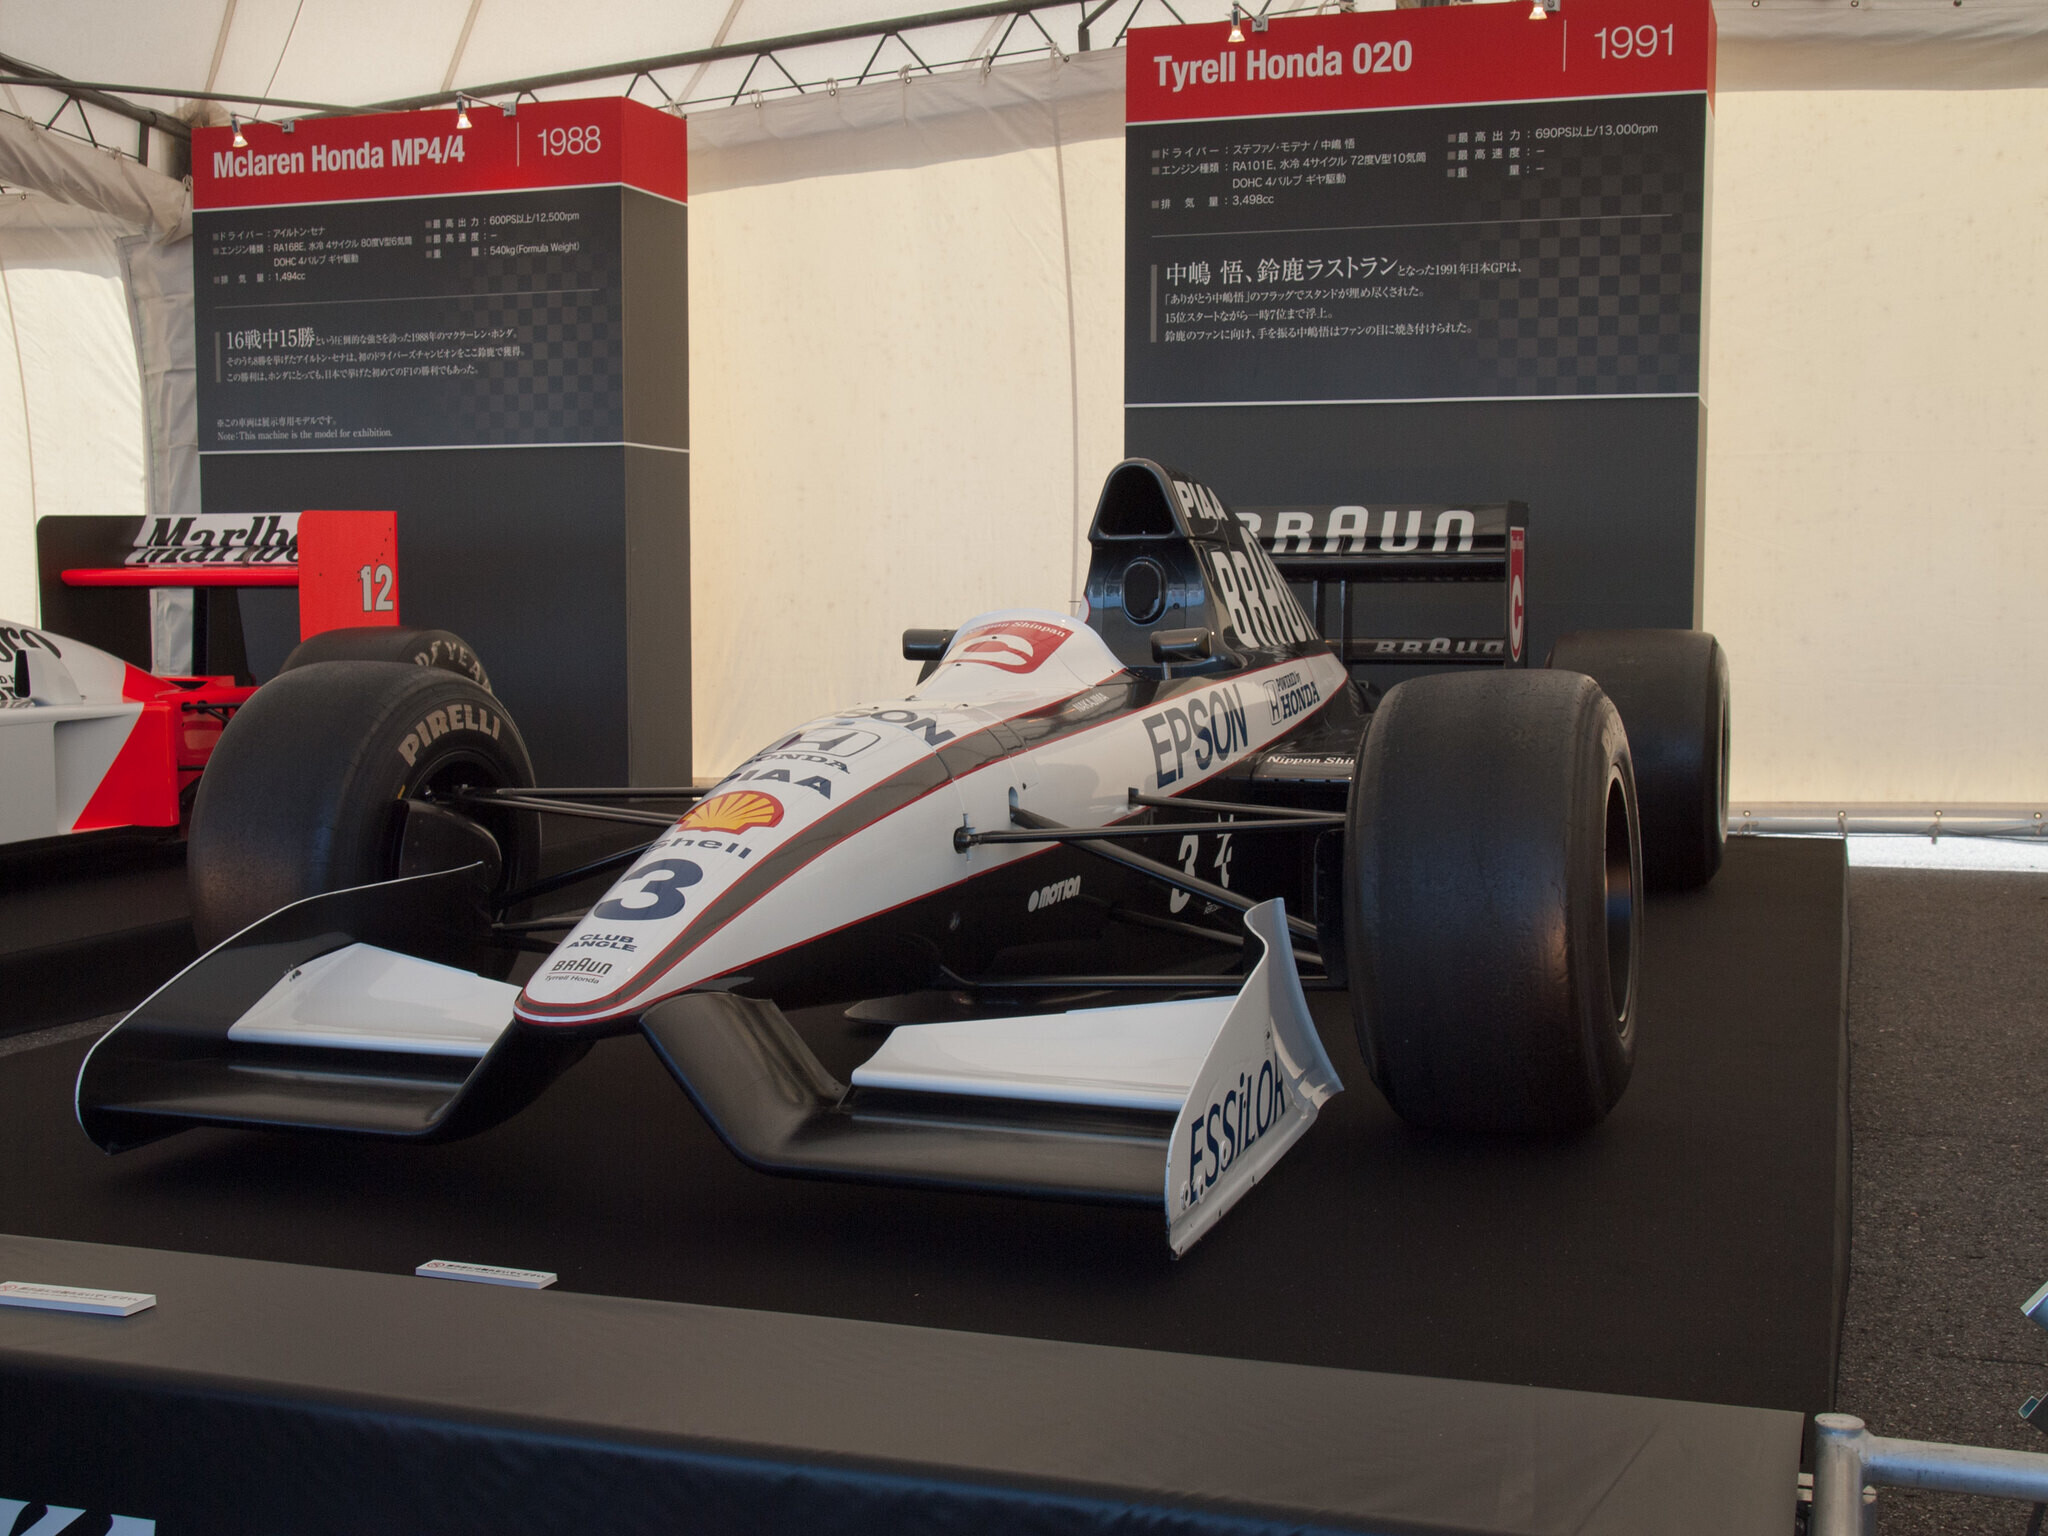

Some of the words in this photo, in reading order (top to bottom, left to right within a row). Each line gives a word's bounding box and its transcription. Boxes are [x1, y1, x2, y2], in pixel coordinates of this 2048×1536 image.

[1594, 23, 1674, 60] 1991
[1154, 50, 1236, 92] Tyrell
[1246, 45, 1342, 82] Honda
[1352, 39, 1413, 74] 020
[537, 125, 601, 157] 1988
[213, 149, 304, 179] Mclaren
[312, 141, 384, 172] Honda
[391, 135, 465, 167] MP4/4
[1233, 177, 1262, 189] DOHC
[1265, 174, 1303, 187] 4バルブ
[273, 256, 297, 267] DOHC
[1166, 260, 1211, 287] 中嶋
[300, 429, 313, 439] the
[315, 428, 338, 439] model
[339, 428, 351, 438] for
[1173, 480, 1229, 521] PIAA
[360, 564, 394, 612] 12
[1011, 621, 1066, 638] Shinpan
[1374, 637, 1505, 655] BRAUN
[1280, 681, 1320, 720] HONDA
[398, 704, 500, 767] PIRELLI
[1142, 684, 1248, 789] EPSON
[1267, 755, 1321, 766] Nippon
[593, 858, 704, 921] 3
[566, 941, 638, 952] ANGLE
[579, 933, 635, 944] CLUB
[552, 957, 613, 975] BRAUN
